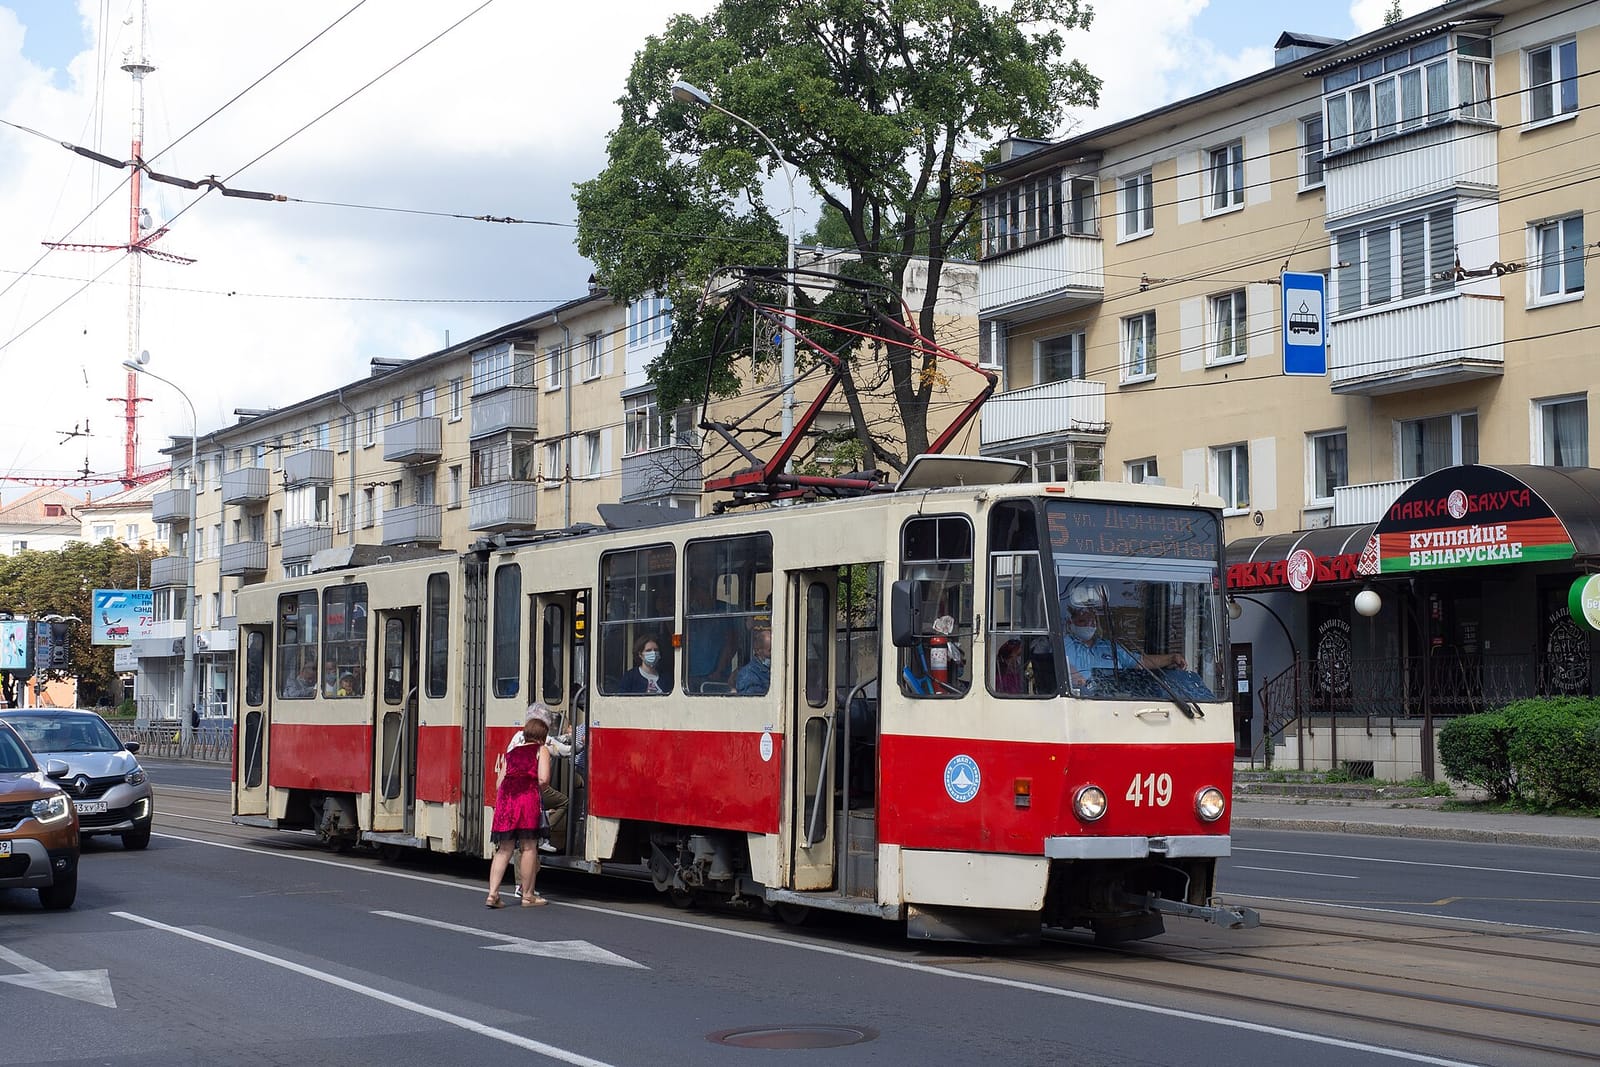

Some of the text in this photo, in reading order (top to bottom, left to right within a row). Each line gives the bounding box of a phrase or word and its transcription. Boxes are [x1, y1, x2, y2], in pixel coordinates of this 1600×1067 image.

[1390, 489, 1531, 521] ЛАВКА БАХУСА
[1047, 512, 1070, 547] 5
[1409, 525, 1508, 549] КУПЛЯЙЦЕ
[1409, 542, 1523, 567] БЕЛАРУСКАЕ
[1318, 619, 1351, 634] НАПИТКИ
[1125, 772, 1173, 807] 419
